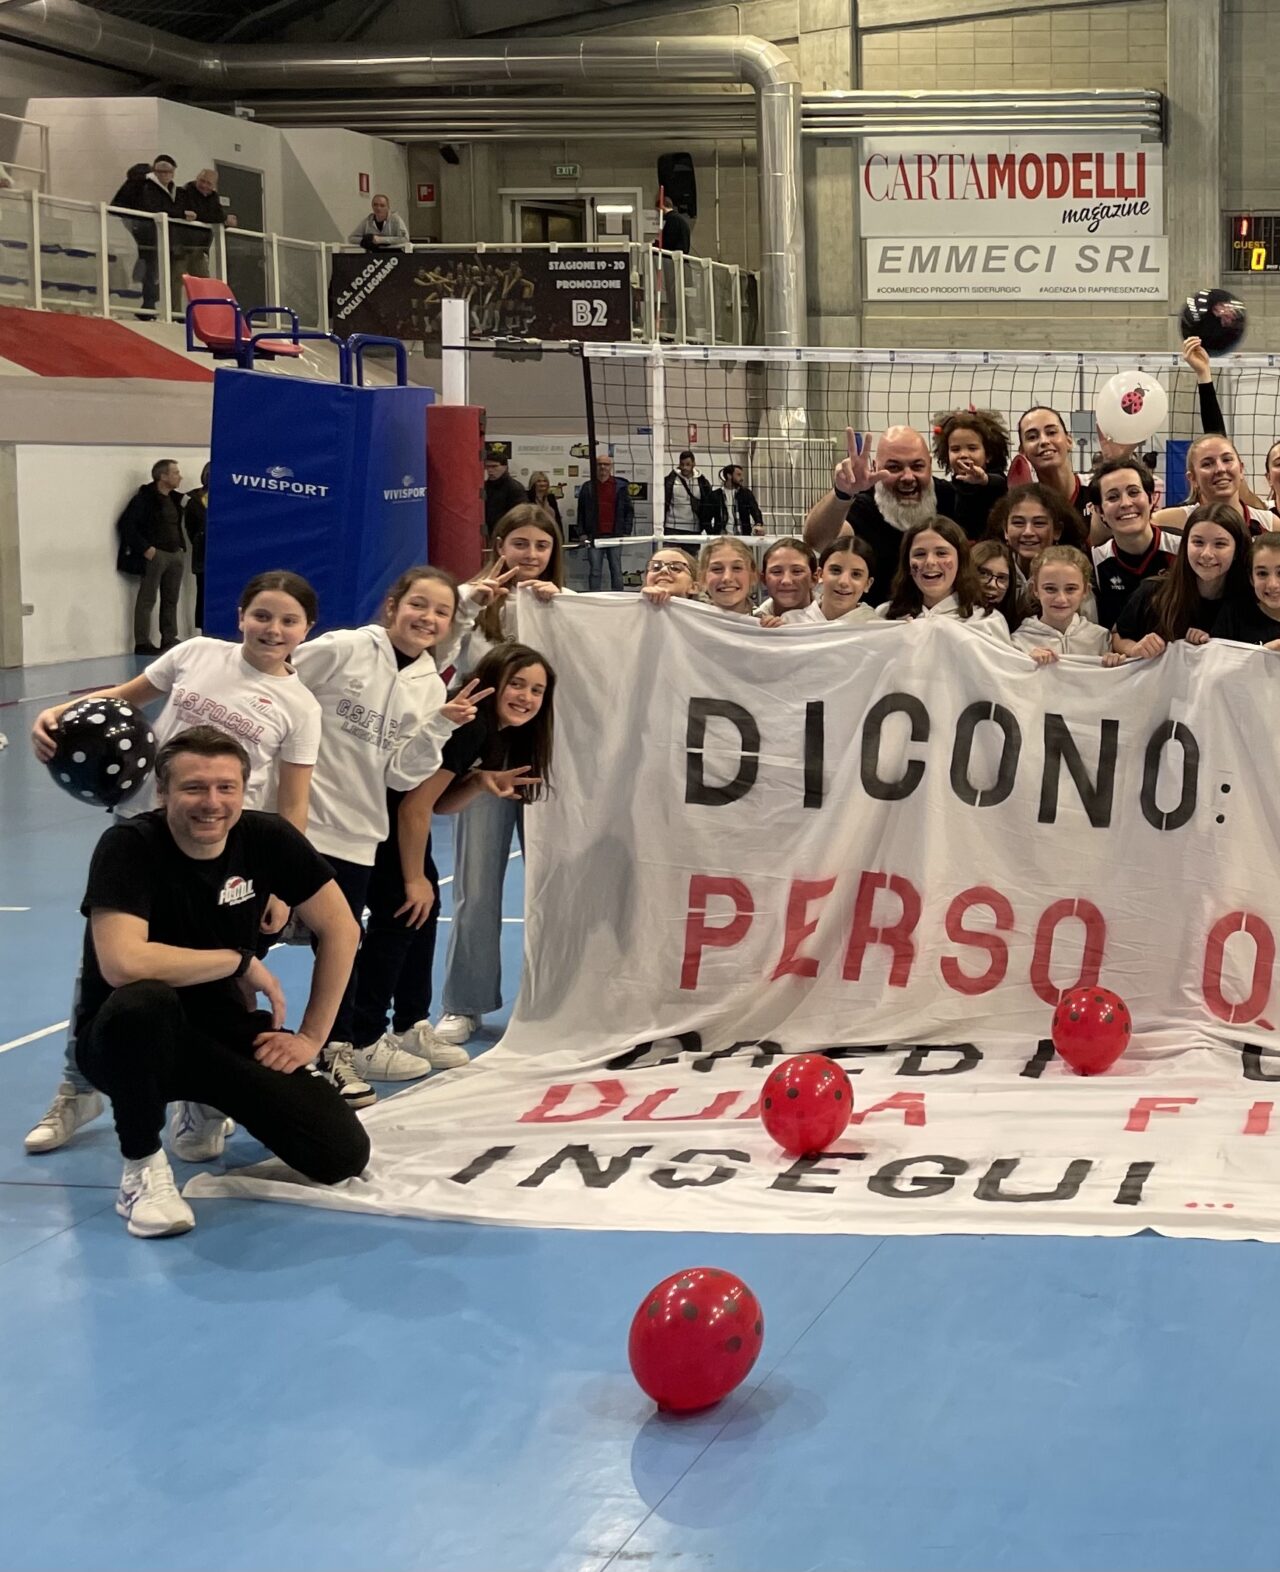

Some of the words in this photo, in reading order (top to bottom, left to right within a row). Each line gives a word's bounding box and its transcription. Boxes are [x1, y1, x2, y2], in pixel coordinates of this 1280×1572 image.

[556, 166, 574, 175] EXIT
[864, 152, 1146, 201] CARTAMODELLI
[1062, 197, 1151, 233] magazine
[1241, 219, 1248, 235] 1
[1233, 241, 1266, 249] GUEST
[548, 261, 595, 270] STAGIONE
[596, 261, 607, 270] 19
[613, 261, 626, 270] 20
[877, 245, 1057, 274] EMMECI
[1075, 245, 1161, 274] SRL
[1251, 248, 1266, 270] 0
[337, 290, 366, 319] VOLLEY
[363, 257, 399, 294] LEGNANO
[556, 280, 621, 289] PROMOZIONE
[877, 286, 929, 294] #COMMERCIO
[930, 286, 970, 294] PRODOTTI
[972, 286, 1022, 294] SIDERURGICI
[1039, 286, 1077, 294] #AGENZIA
[1079, 286, 1086, 294] DI
[1088, 286, 1160, 294] RAPPRESENTANZA
[572, 299, 608, 327] B2
[231, 473, 329, 497] VIVISPORT
[685, 692, 1231, 832] DICONO:
[679, 870, 1106, 1007] PERSO
[516, 1079, 927, 1125] DUA
